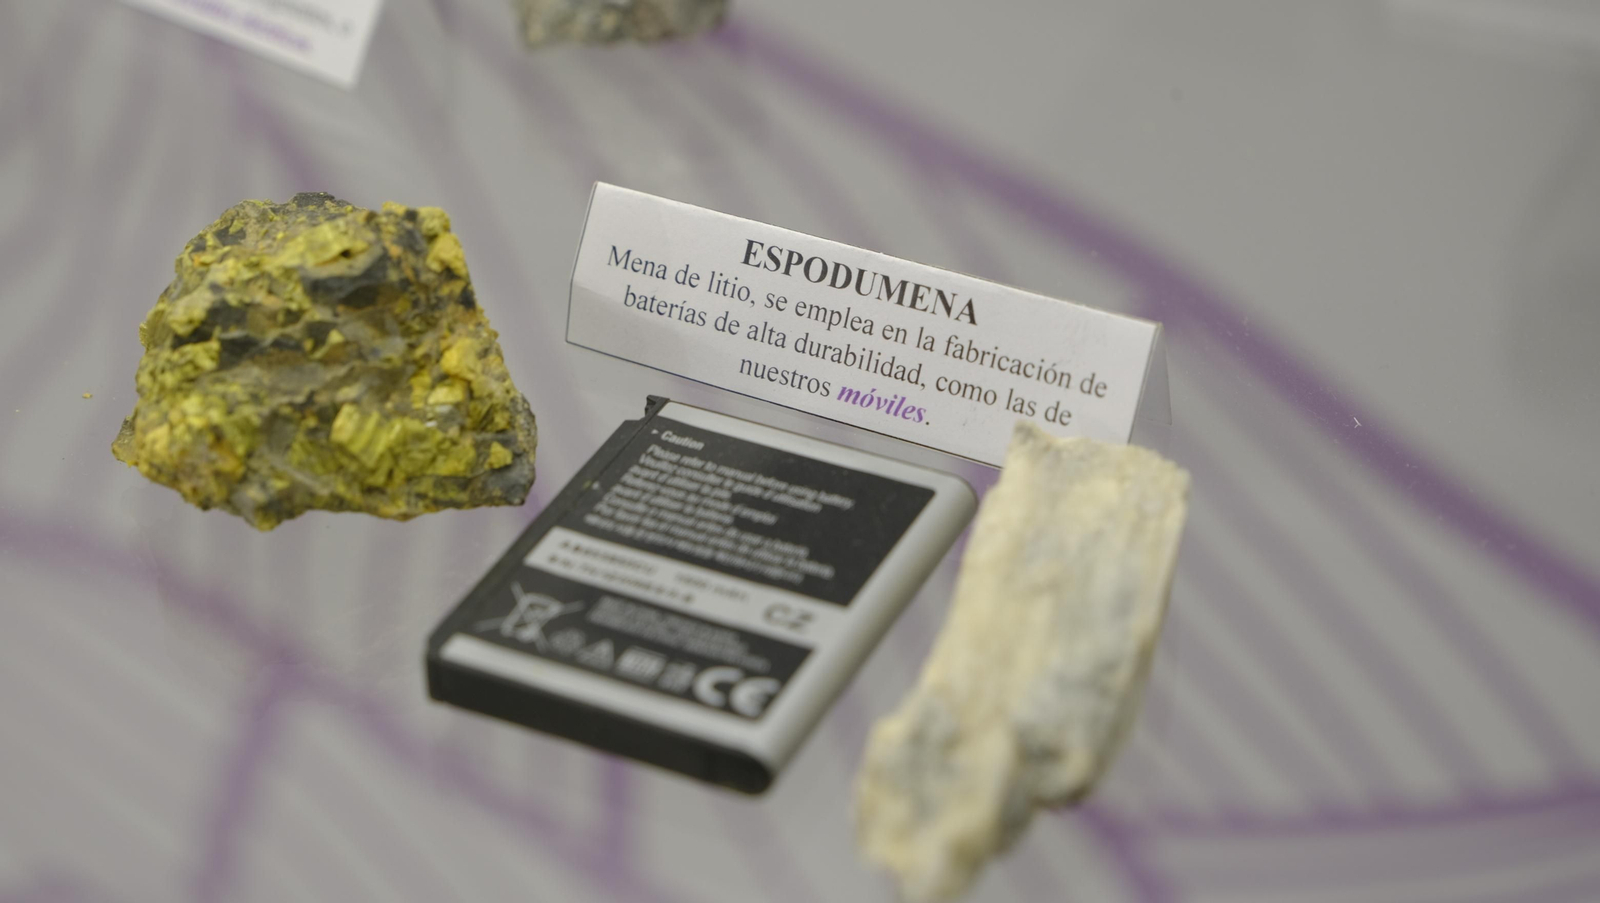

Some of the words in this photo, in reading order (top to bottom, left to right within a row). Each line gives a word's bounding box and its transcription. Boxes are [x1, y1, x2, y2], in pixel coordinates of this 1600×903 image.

[607, 244, 667, 280] Mena
[674, 264, 701, 288] de
[707, 270, 756, 308] litio,
[764, 291, 788, 312] se
[794, 301, 874, 337] emplea
[881, 323, 908, 345] en
[916, 326, 936, 352] la
[943, 334, 1072, 390] fabricación
[1079, 372, 1108, 399] de
[739, 238, 979, 326] ESPODUMENA
[623, 285, 707, 327] baterías
[714, 310, 740, 336] de
[746, 321, 787, 349] alta
[794, 332, 926, 390] durabilidad,
[935, 375, 998, 406] como
[1005, 387, 1037, 418] las
[1044, 400, 1073, 427] de
[738, 358, 832, 398] nuestros
[835, 384, 931, 426] móviles.
[660, 429, 705, 452] Caution
